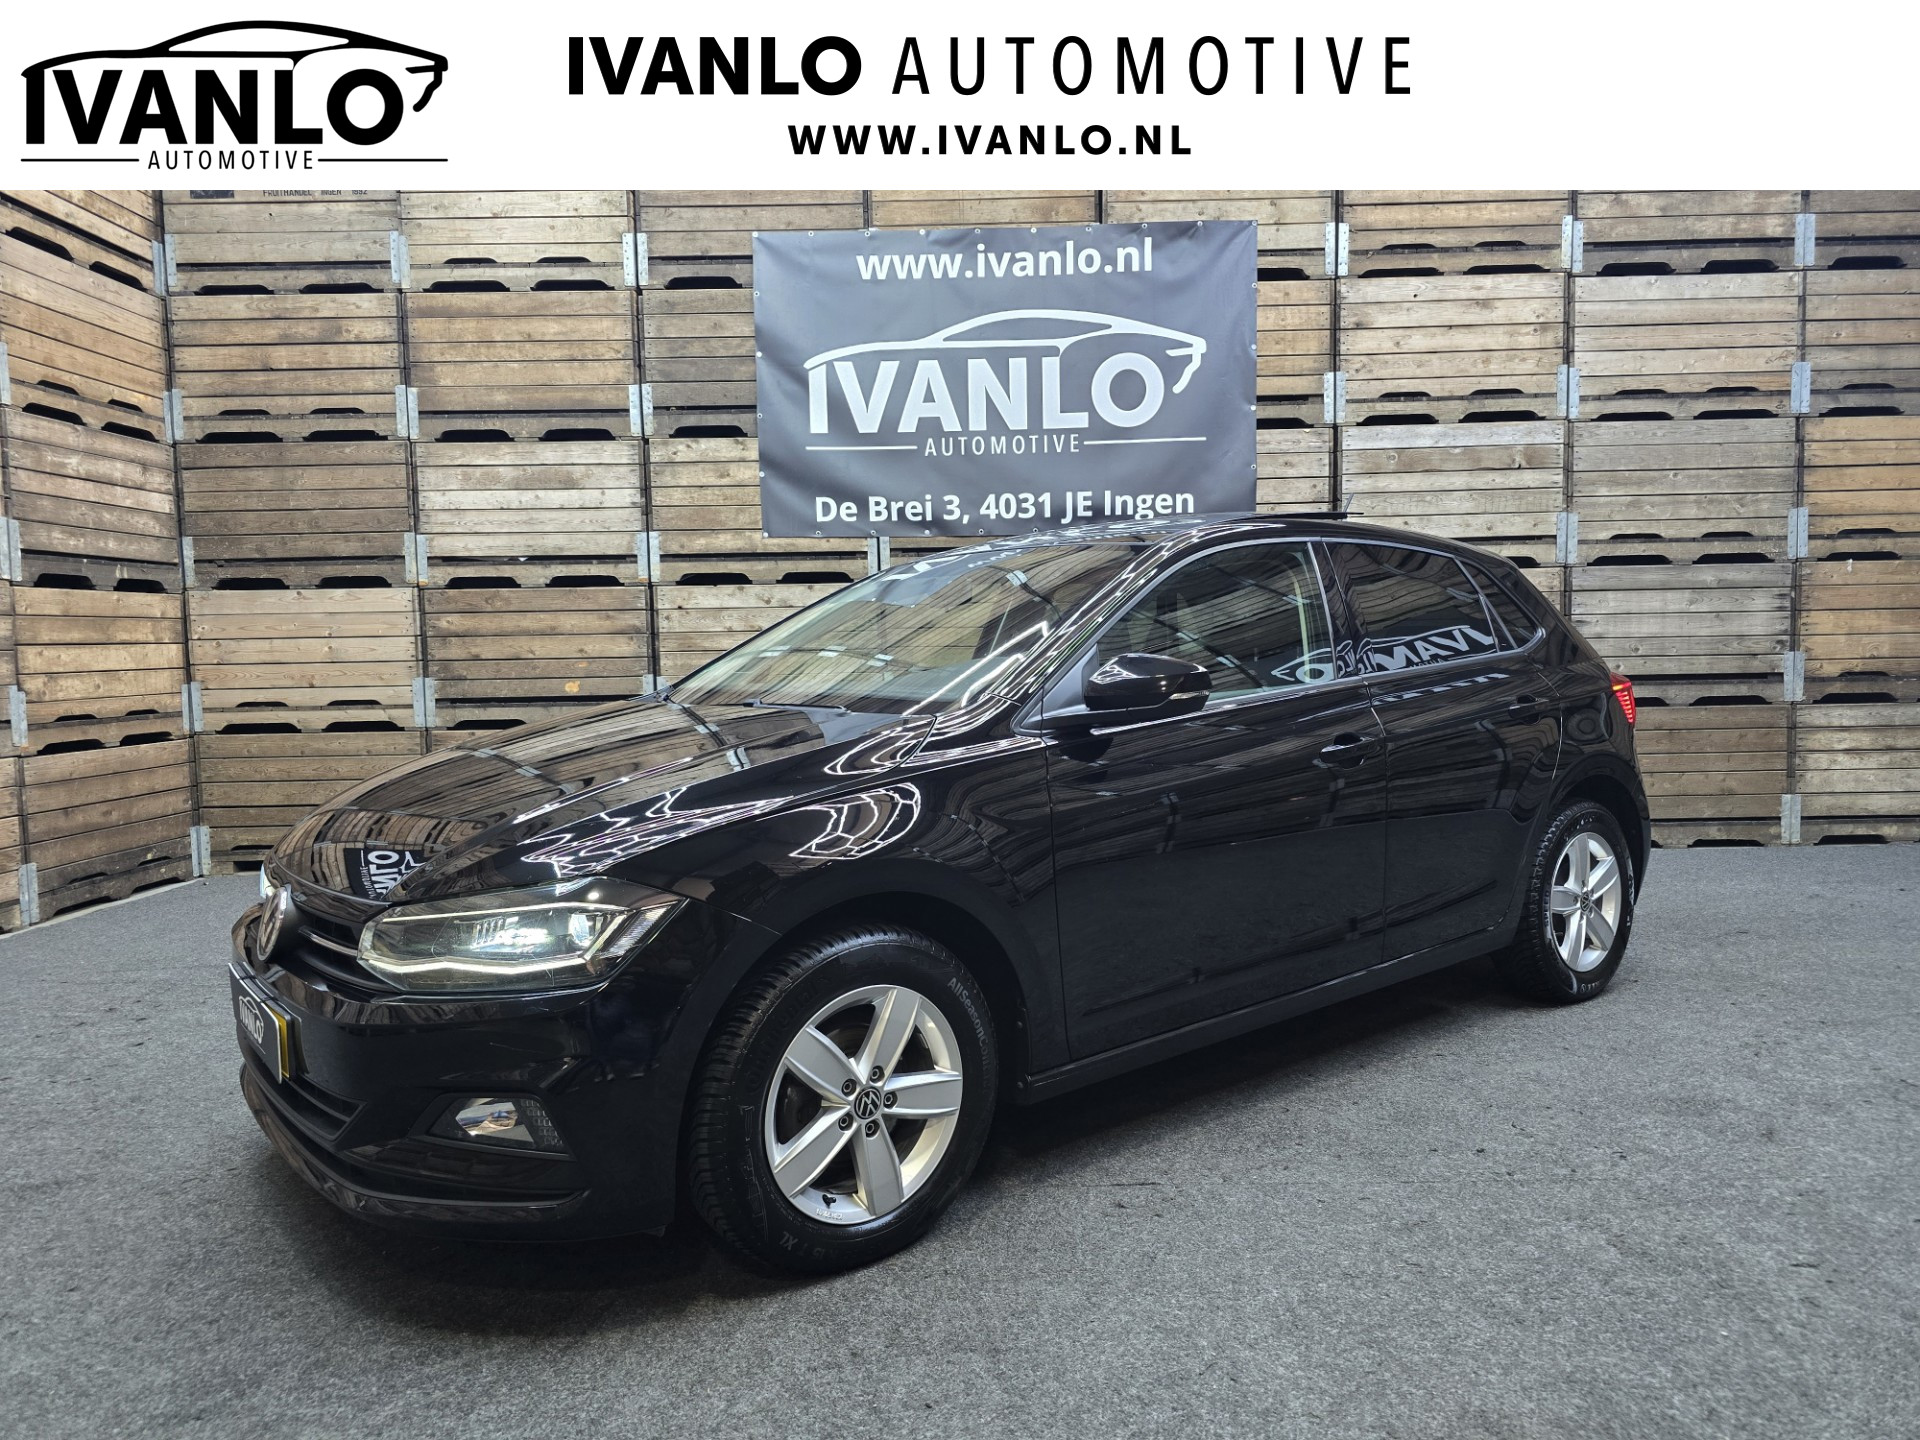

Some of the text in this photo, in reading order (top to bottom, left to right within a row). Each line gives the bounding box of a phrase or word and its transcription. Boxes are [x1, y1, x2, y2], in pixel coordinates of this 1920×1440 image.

[856, 237, 1153, 279] www.ivanlo.nl
[808, 352, 1165, 434] IVANLO
[924, 434, 1080, 457] AUTOMOTIVE
[815, 490, 1195, 525] De Brei 3, 4031 JE Ingen
